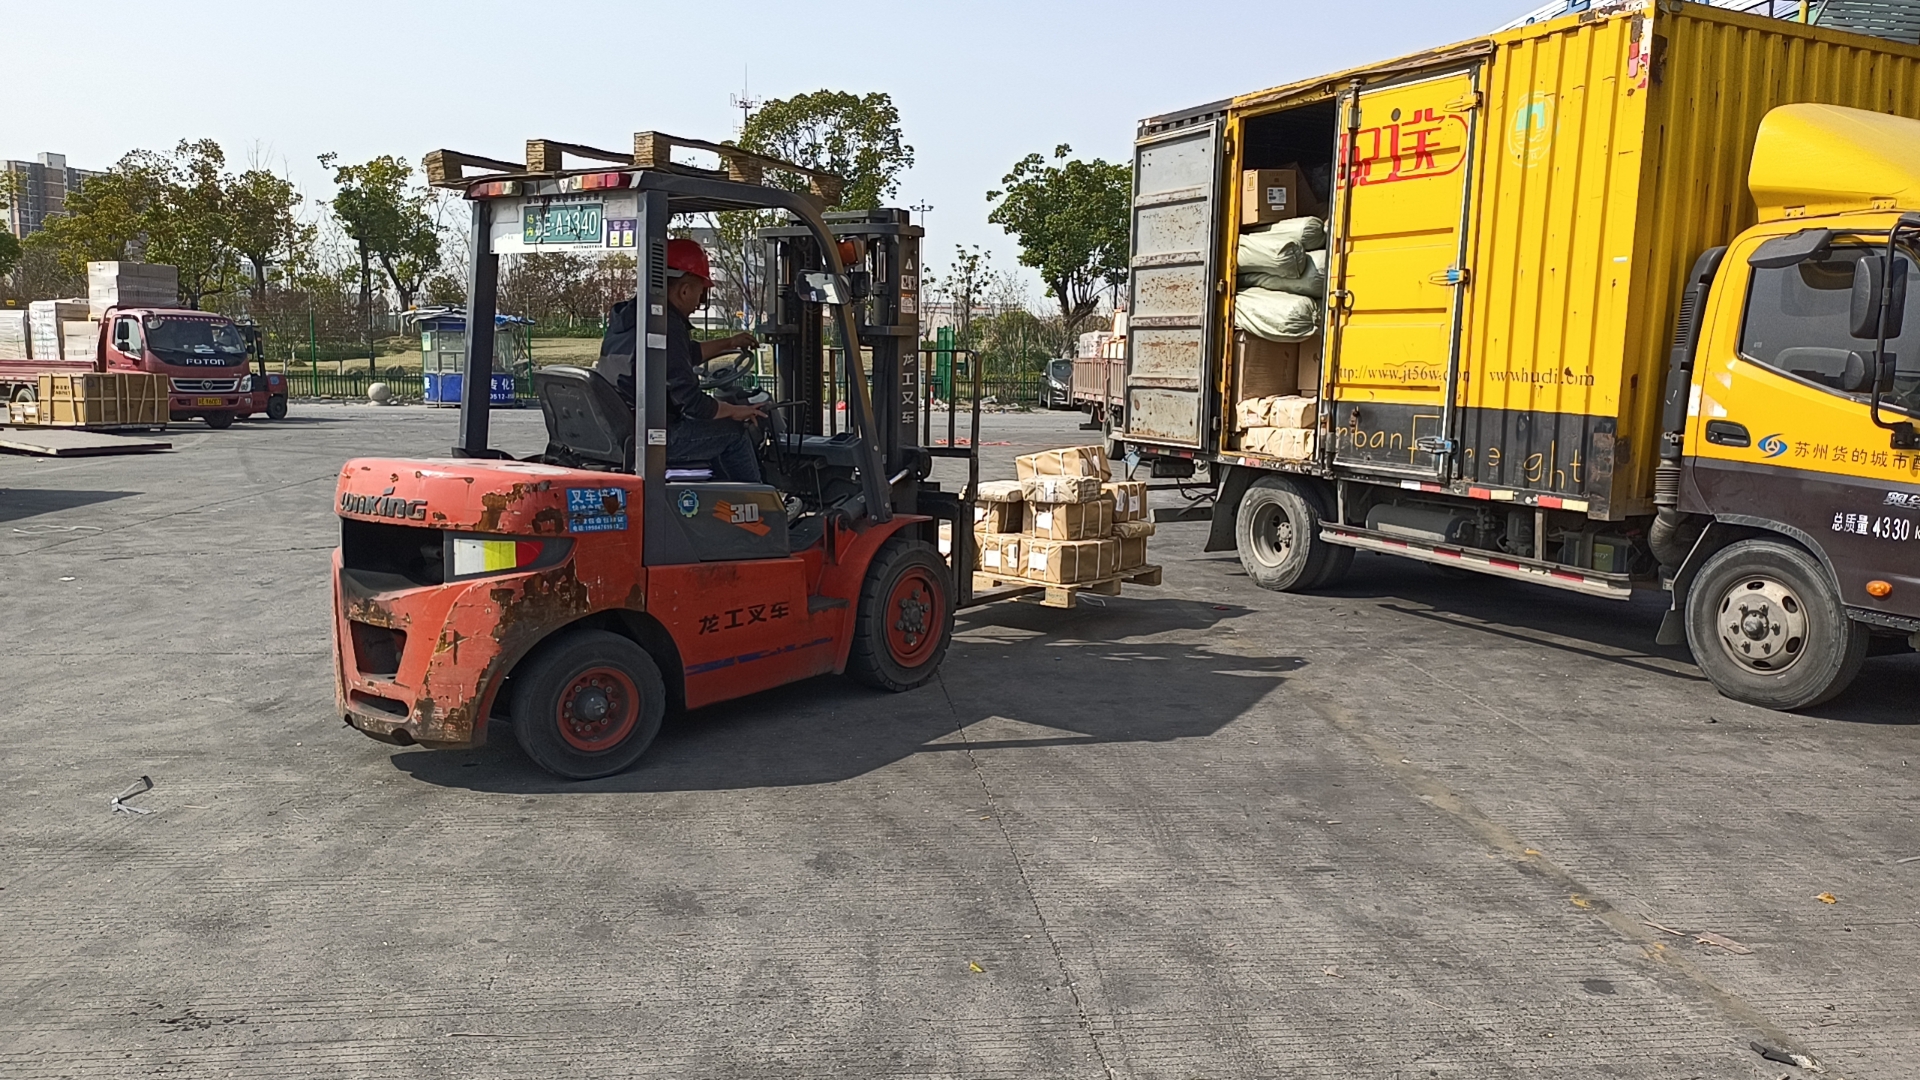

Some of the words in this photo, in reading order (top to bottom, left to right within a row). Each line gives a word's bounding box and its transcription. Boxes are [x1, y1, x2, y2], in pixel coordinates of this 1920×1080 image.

[186, 358, 226, 366] FOTON
[1335, 418, 1403, 451] rban
[730, 503, 760, 524] 30
[1831, 512, 1869, 535] 总质量
[1872, 516, 1911, 541] 4330
[698, 601, 790, 636] 龙工叉车
